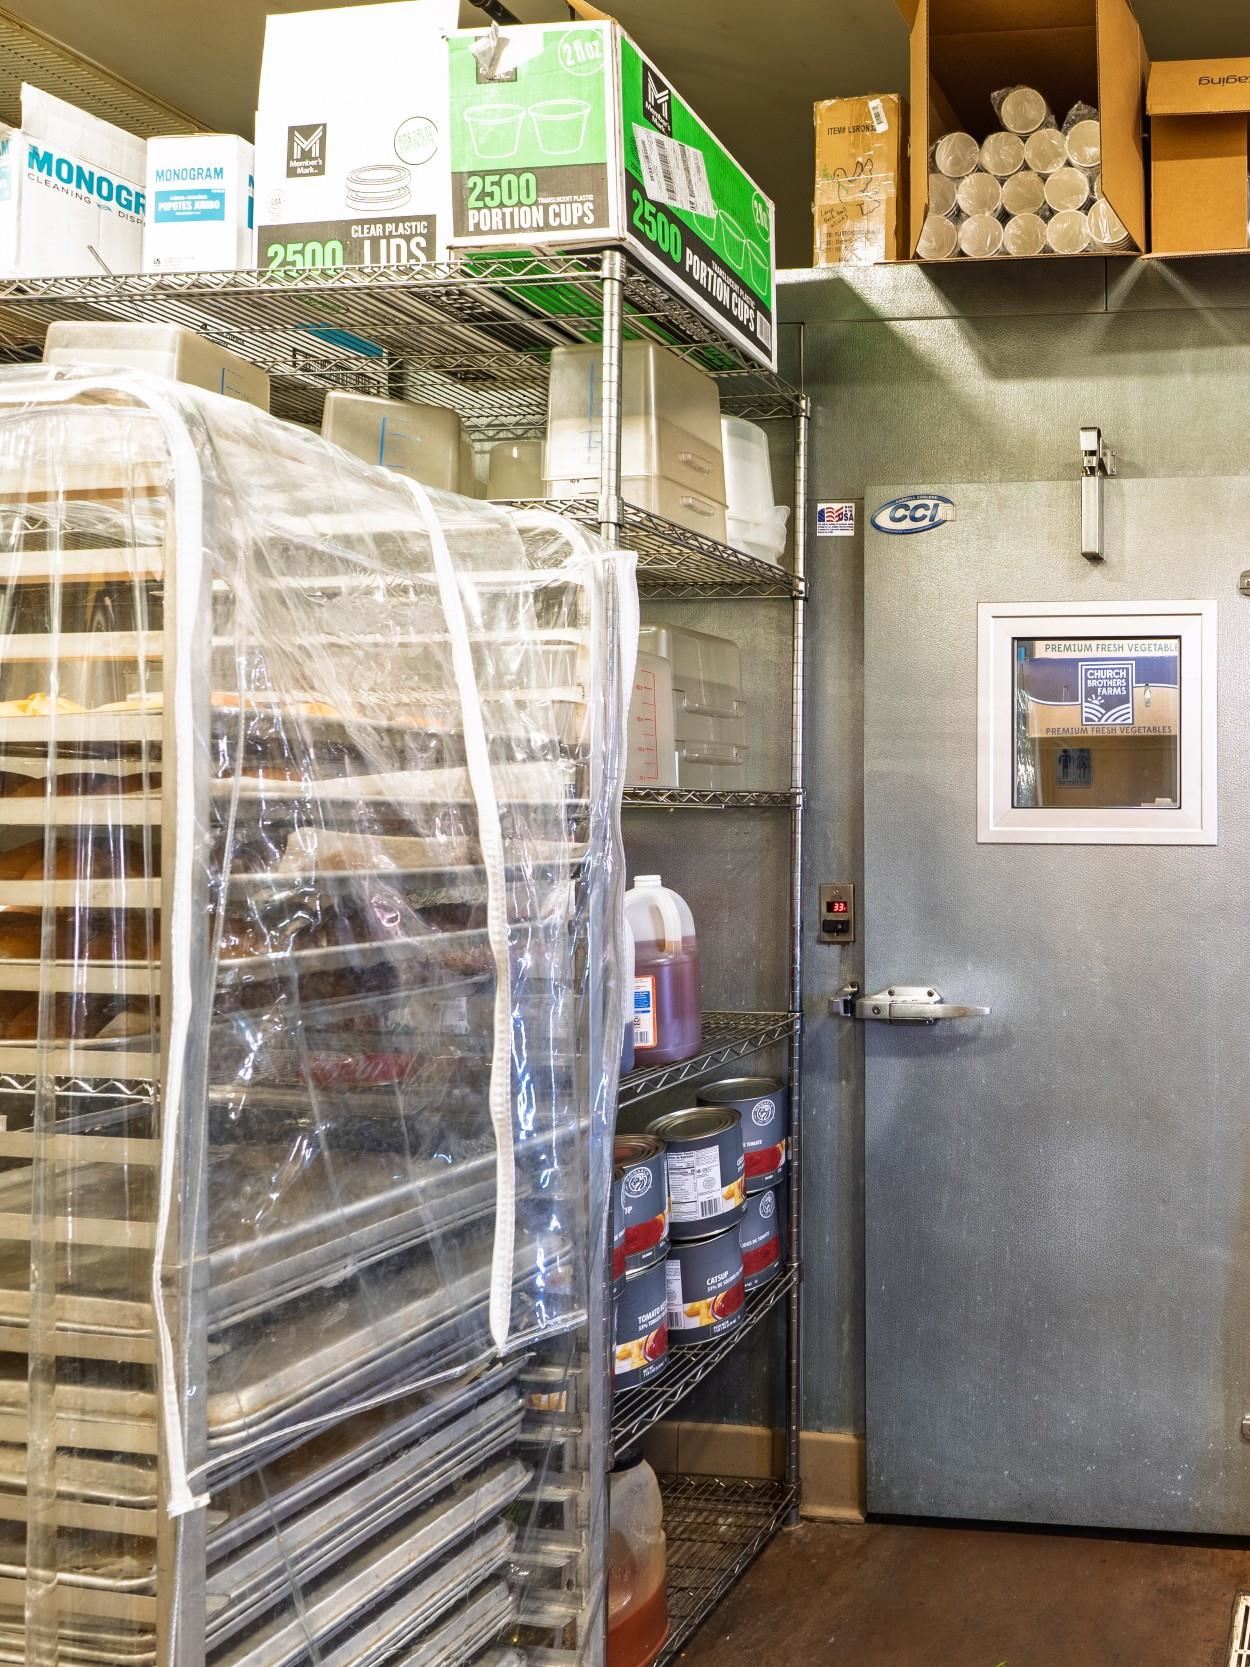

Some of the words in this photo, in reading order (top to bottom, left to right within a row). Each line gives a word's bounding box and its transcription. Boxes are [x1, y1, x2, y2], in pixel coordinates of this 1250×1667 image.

[645, 101, 671, 131] Member's
[289, 158, 323, 168] Member's
[155, 167, 224, 182] MONOGRAM
[27, 172, 92, 205] CLEANING
[467, 172, 537, 209] 2500
[468, 205, 544, 232] PORTION
[549, 202, 595, 227] CUPS
[351, 225, 383, 238] CLEAR
[385, 221, 428, 237] PLASTIC
[632, 189, 682, 264] 2500
[266, 239, 344, 277] 2500
[363, 236, 428, 273] LIDS
[685, 246, 730, 310] PORTION
[731, 291, 755, 333] CUPS
[888, 502, 940, 523] CCI
[1044, 643, 1093, 653] PREMIUM
[1096, 643, 1124, 652] FRESH
[1087, 669, 1127, 679] CHURCH
[1087, 679, 1127, 687] BROTHERS
[1097, 687, 1127, 696] FARMS
[1045, 726, 1089, 735] PREMIUM
[1091, 726, 1117, 735] FRESH
[1119, 726, 1172, 735] VEGETABLES
[706, 1270, 729, 1286] CATSUP
[638, 1306, 661, 1324] TOMATO
